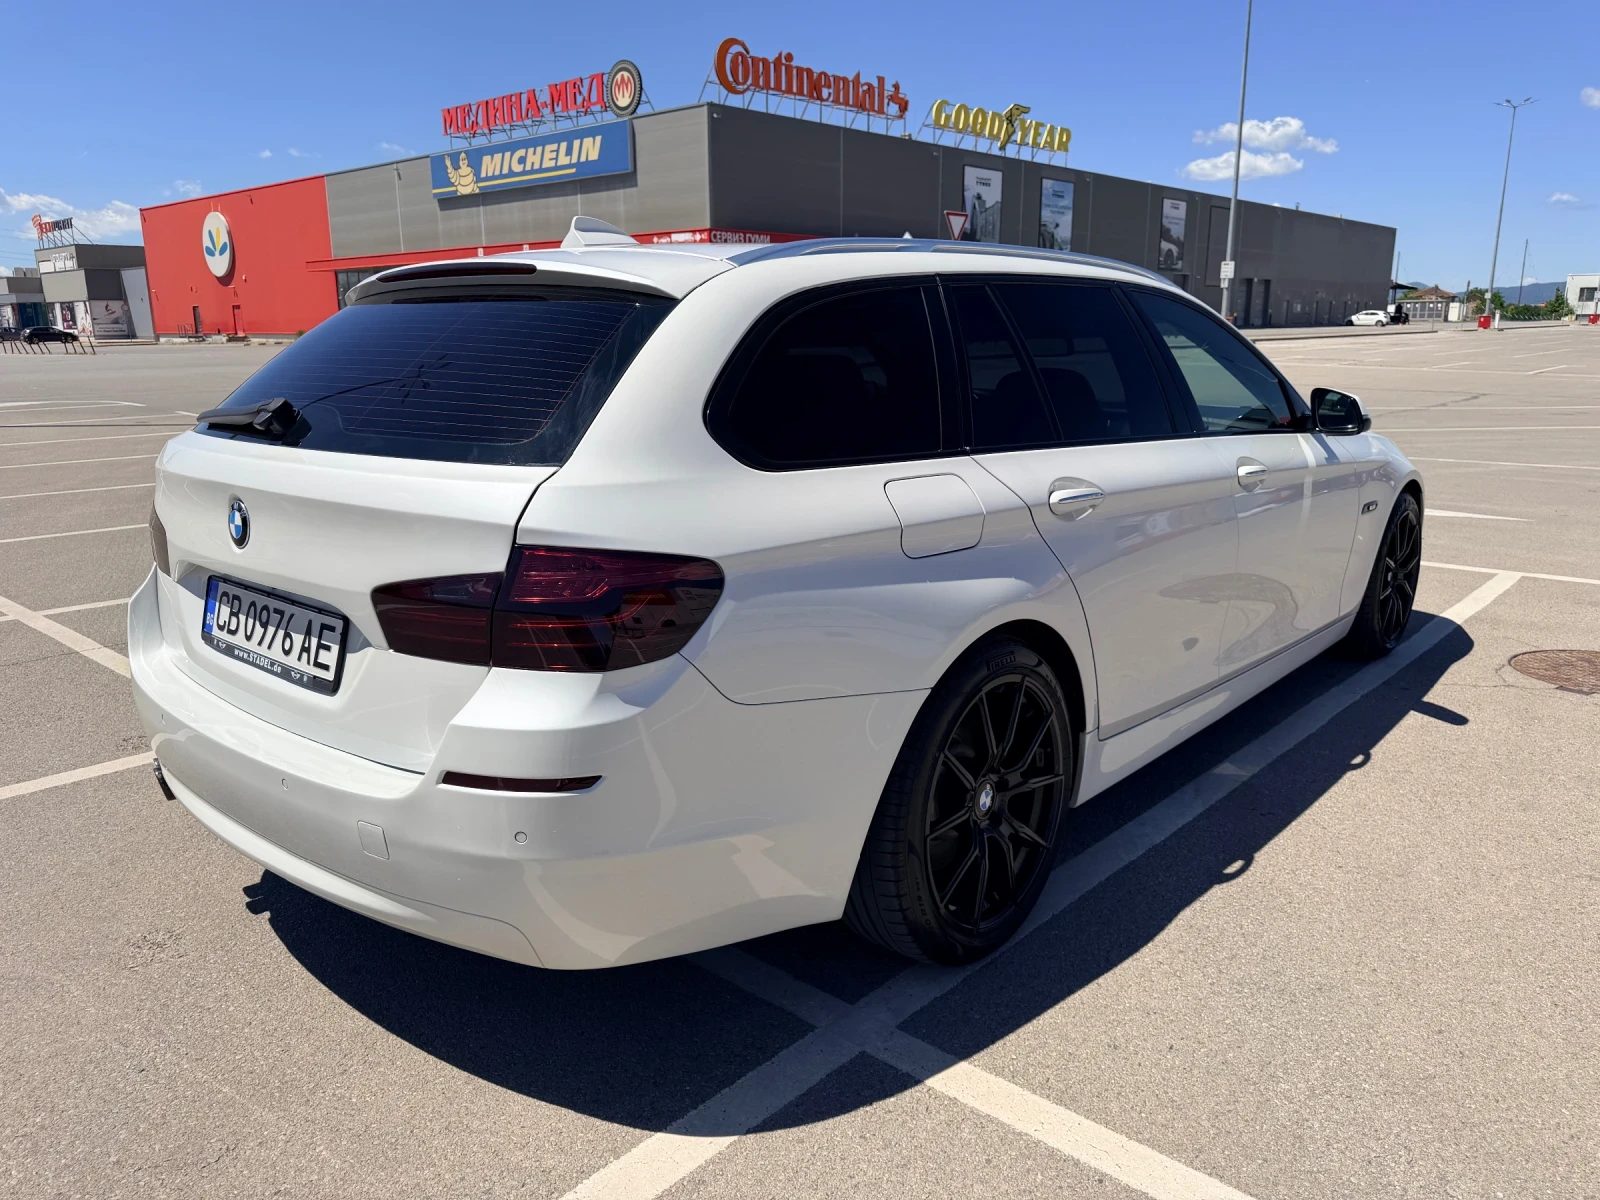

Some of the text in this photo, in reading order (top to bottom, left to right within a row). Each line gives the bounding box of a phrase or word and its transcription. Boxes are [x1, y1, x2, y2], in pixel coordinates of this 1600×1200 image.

[715, 37, 885, 115] Continental
[441, 72, 607, 138] МЕДИНА-МЕД
[480, 135, 602, 178] MICHELIN
[710, 230, 745, 244] СЕРВИЗ
[206, 612, 215, 626] BG
[244, 600, 295, 658] 0976
[297, 618, 337, 672] AE
[986, 650, 1017, 672] PIRELLI
